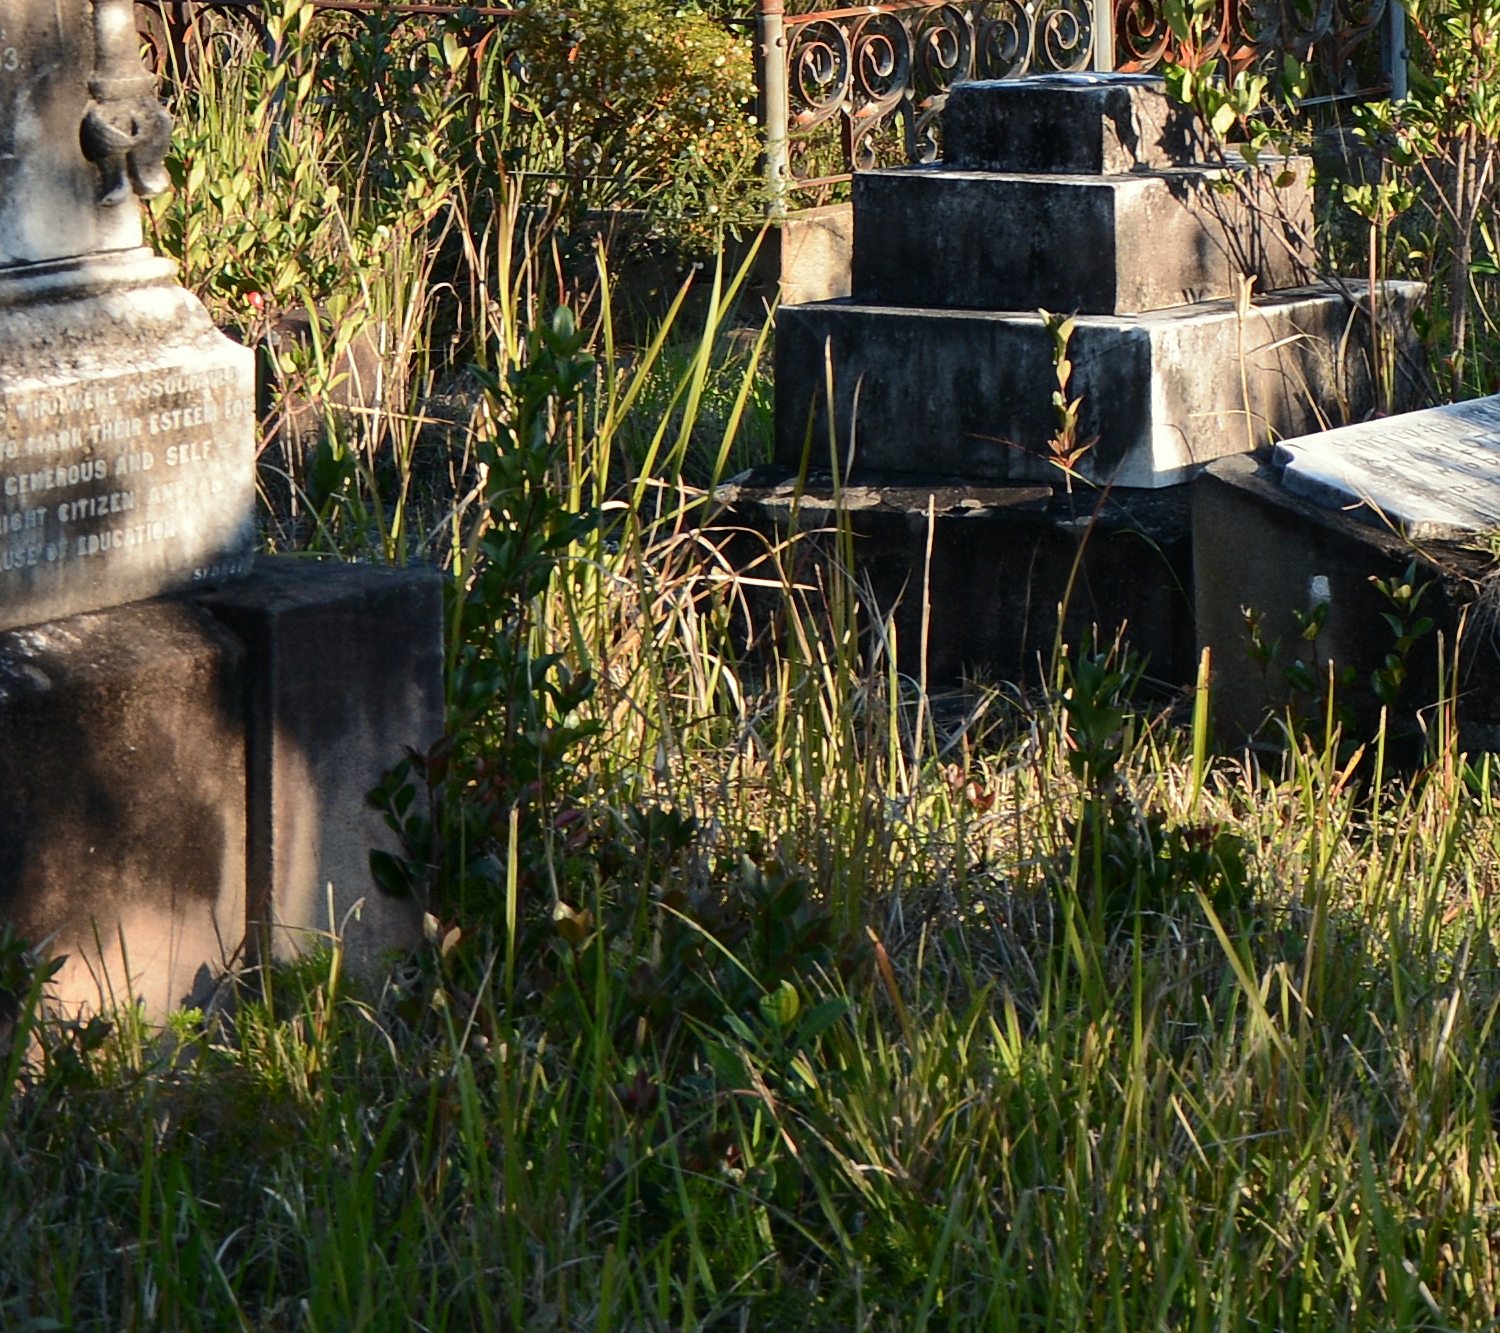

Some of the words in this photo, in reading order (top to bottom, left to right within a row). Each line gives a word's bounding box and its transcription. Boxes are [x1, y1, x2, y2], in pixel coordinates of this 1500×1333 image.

[91, 417, 142, 444] THEIR
[5, 459, 108, 496] GENEROUS
[115, 450, 155, 476] AND
[58, 491, 135, 522] CITIZEN
[78, 519, 176, 557] EDUCATION
